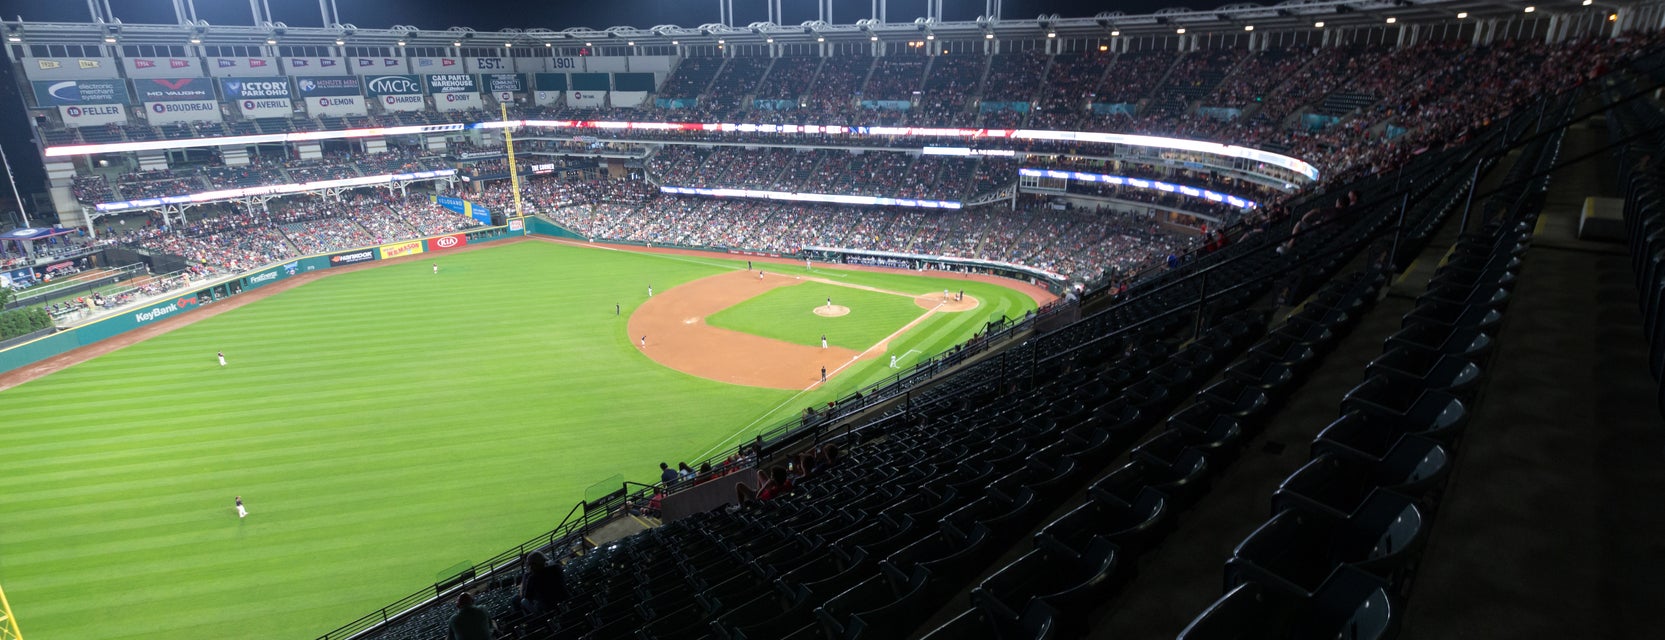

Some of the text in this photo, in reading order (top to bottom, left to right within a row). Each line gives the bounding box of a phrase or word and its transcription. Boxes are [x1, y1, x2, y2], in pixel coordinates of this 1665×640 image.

[478, 58, 504, 69] EST.
[553, 58, 575, 69] 1901
[82, 107, 118, 116] FELLER
[166, 103, 213, 112] BOUDREAU
[440, 238, 455, 246] KIA
[136, 303, 177, 322] KeyBank
